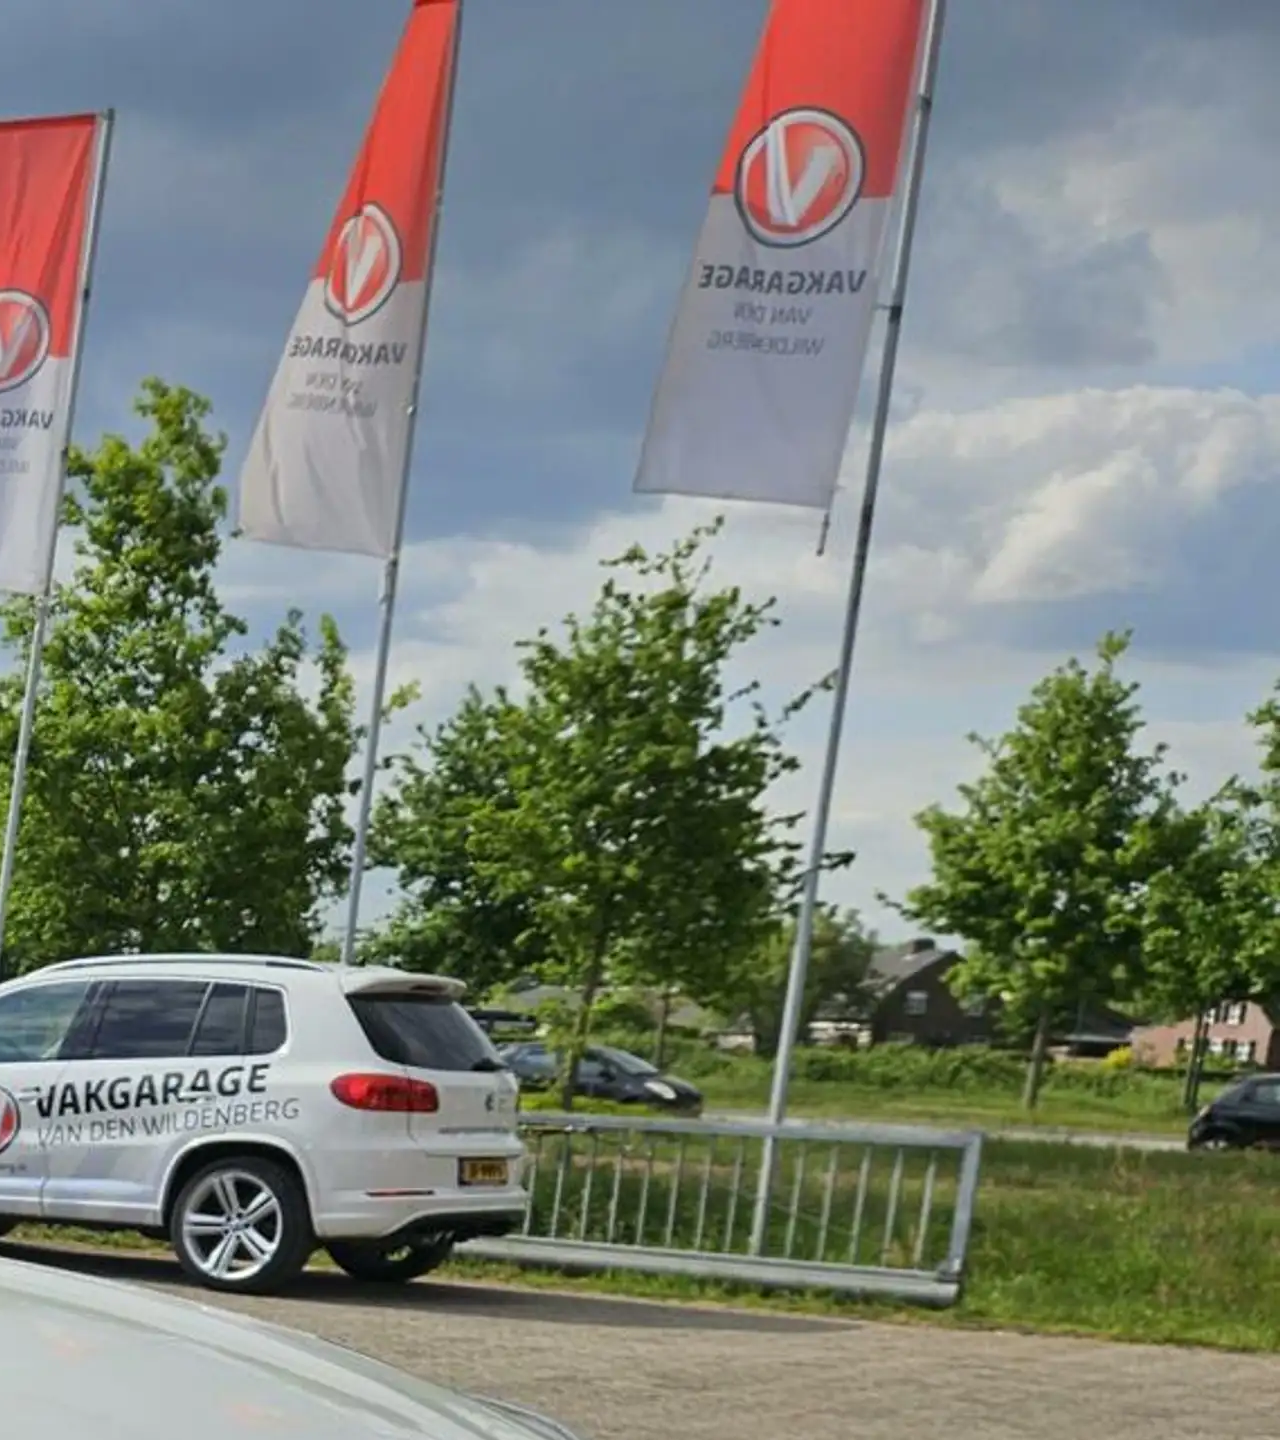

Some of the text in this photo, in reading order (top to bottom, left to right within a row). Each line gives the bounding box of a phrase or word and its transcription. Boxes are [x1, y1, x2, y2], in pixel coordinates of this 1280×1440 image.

[37, 1064, 270, 1117] VAKGARAGE
[89, 1115, 136, 1141] DEN
[142, 1098, 300, 1137] WILDENBERG
